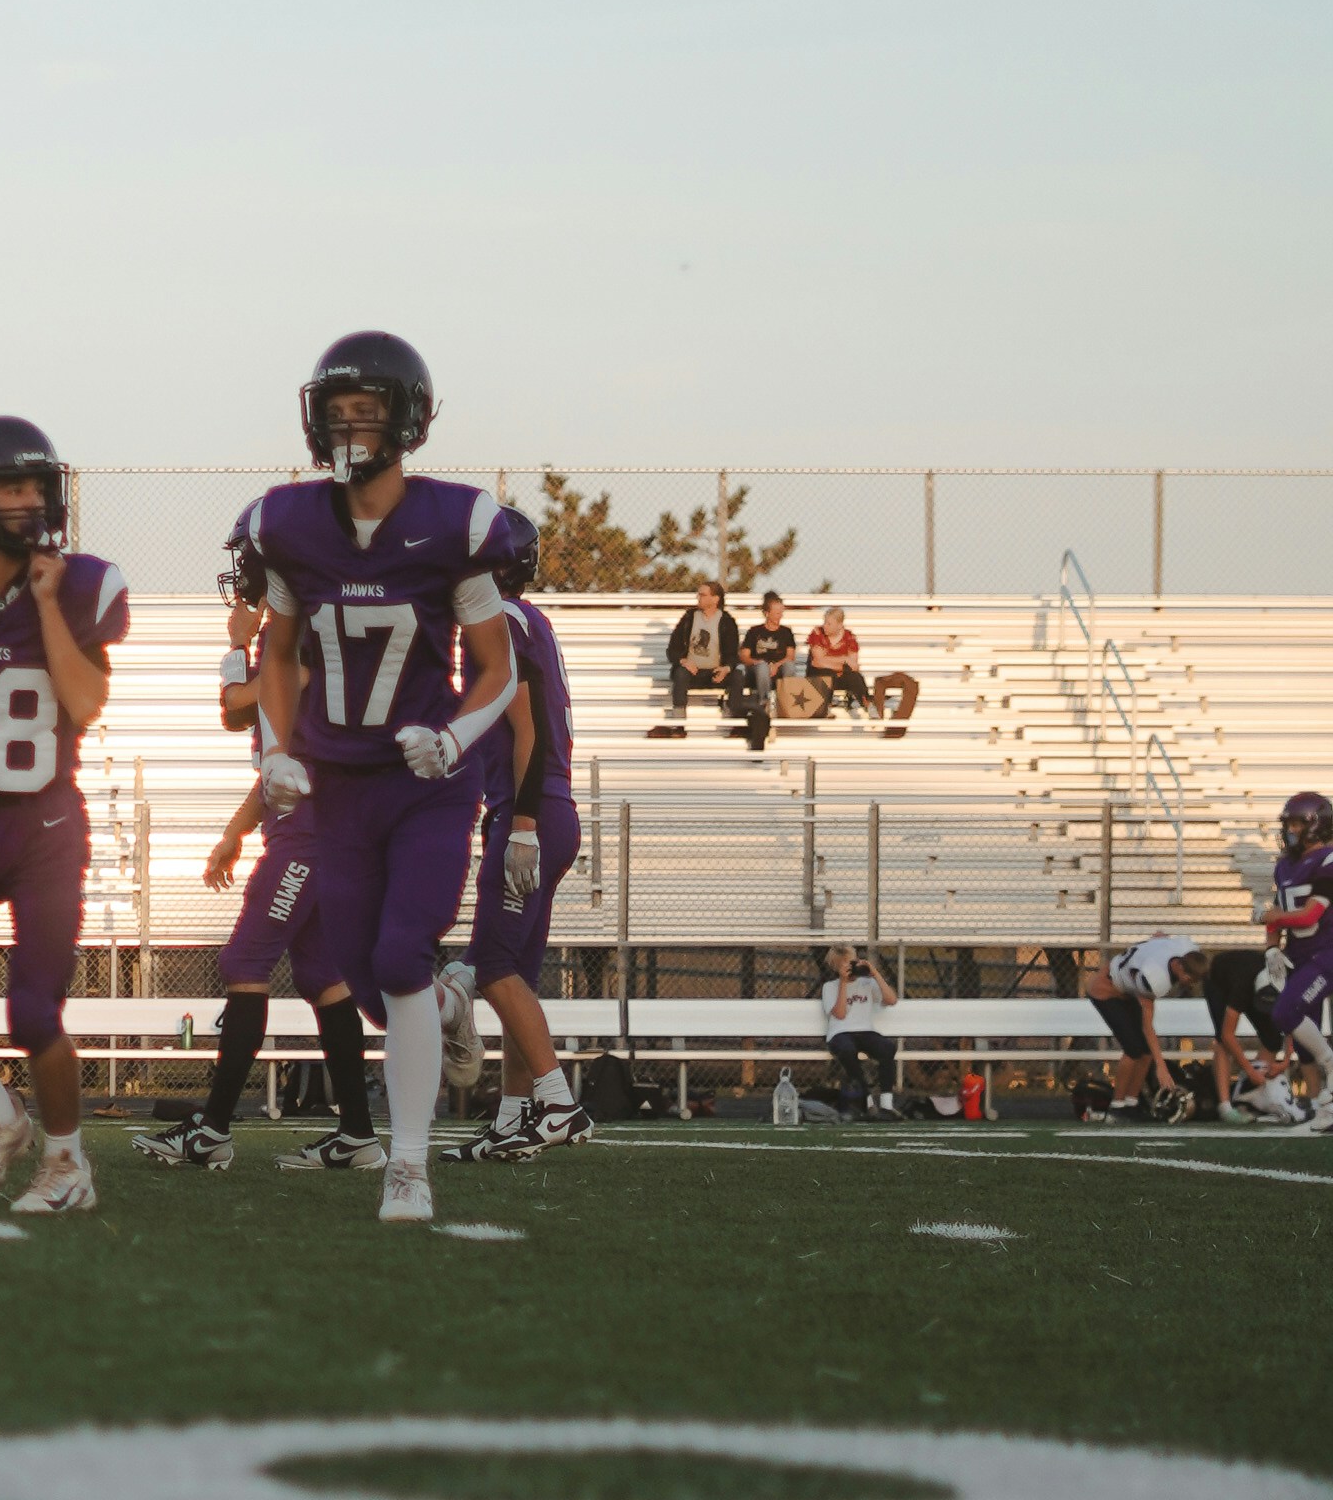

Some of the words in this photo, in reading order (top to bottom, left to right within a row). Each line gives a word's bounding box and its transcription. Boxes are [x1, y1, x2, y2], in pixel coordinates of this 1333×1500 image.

[341, 584, 385, 598] HAWKS
[310, 603, 418, 726] 17
[268, 861, 310, 922] HAWKS
